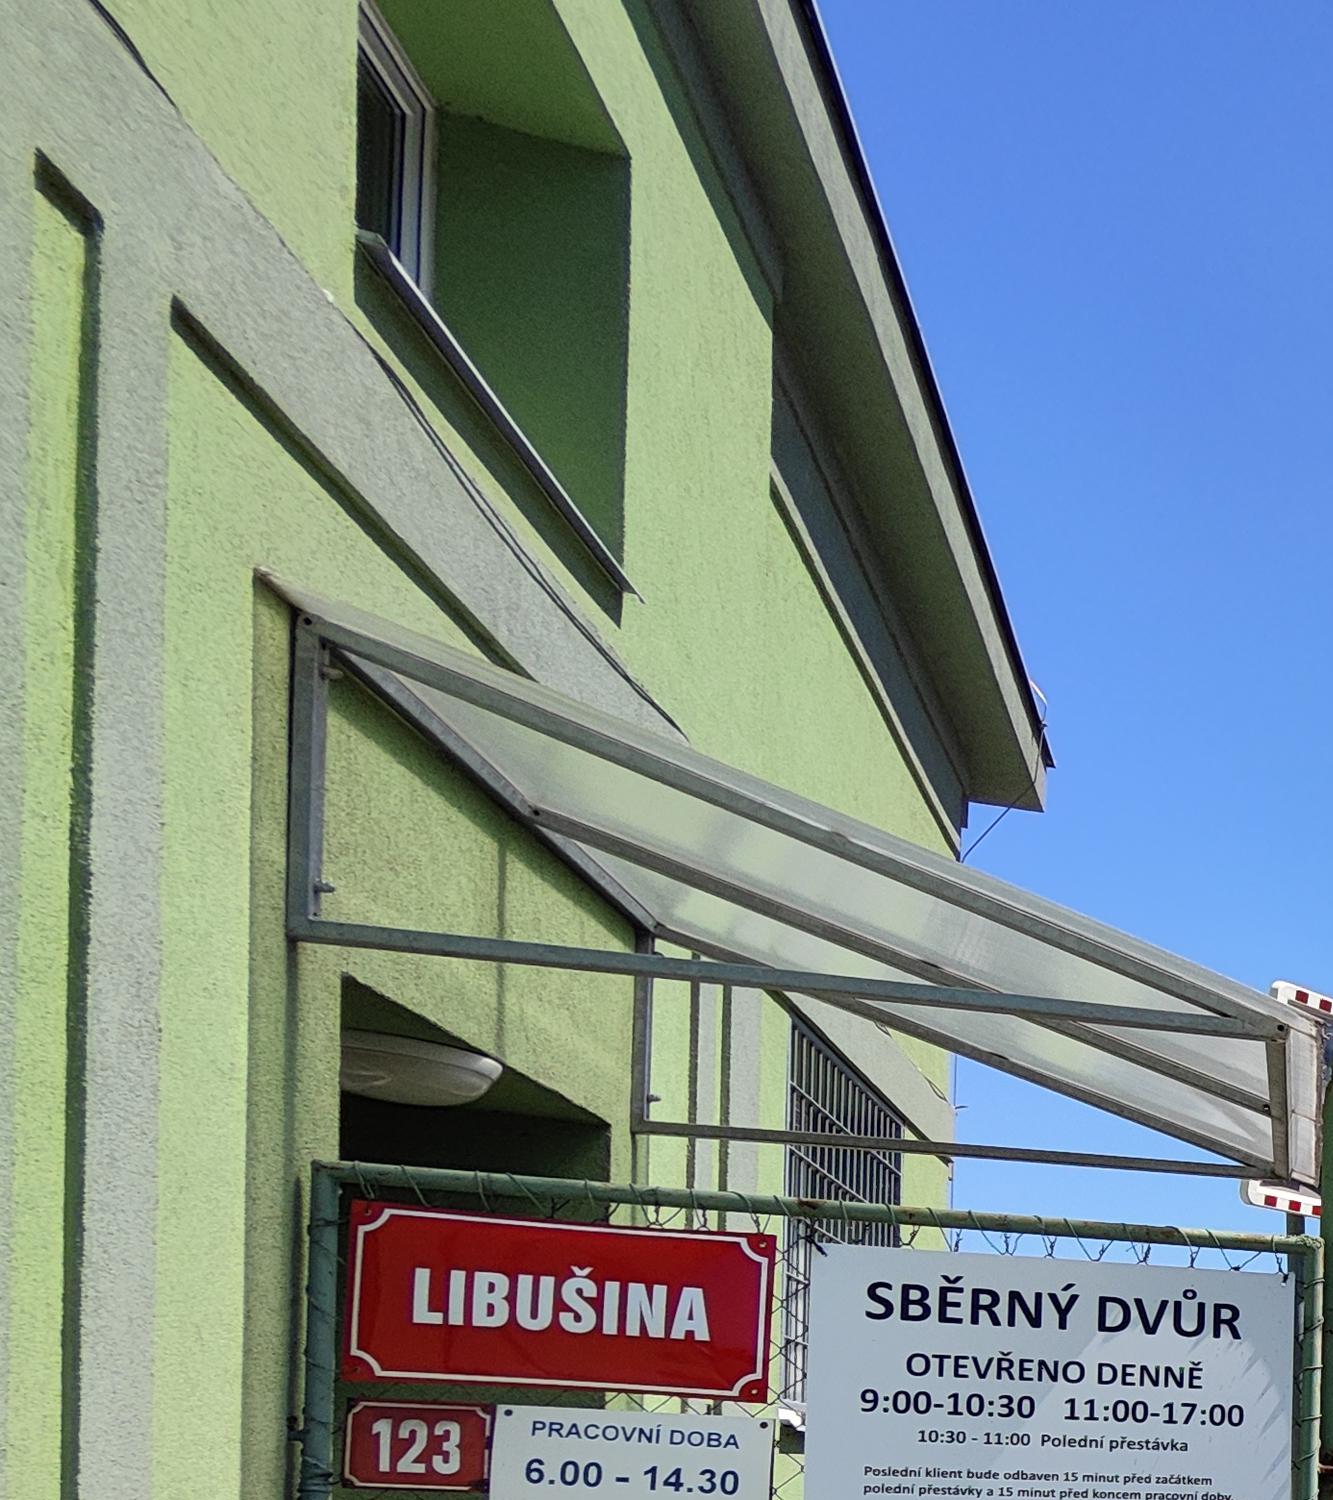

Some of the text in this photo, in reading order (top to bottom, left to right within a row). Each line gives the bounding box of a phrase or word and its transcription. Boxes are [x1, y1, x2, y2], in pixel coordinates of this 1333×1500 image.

[411, 1266, 710, 1341] LIBUŠINA
[864, 1275, 1242, 1340] SBĚRNÝ DVŮR
[905, 1351, 1203, 1390] OTEVŘENO DENNĚ
[859, 1388, 1244, 1427] 9:00-10:30 11:00-17:00
[371, 1418, 461, 1474] 123
[530, 1420, 740, 1450] PRACOVNÍ DOBA
[917, 1429, 966, 1446] 10:30
[983, 1432, 1031, 1448] 11:00
[1040, 1433, 1104, 1450] Polední
[1109, 1435, 1189, 1455] přestávka
[524, 1458, 604, 1488] 6.00
[642, 1465, 740, 1496] 14.30
[863, 1466, 1212, 1486] Poslední klient bude odbaven 15 minut před začátkem
[863, 1483, 915, 1496] polední
[918, 1484, 983, 1498] přestávky
[986, 1488, 994, 1497] a
[998, 1487, 1014, 1497] 15
[1017, 1487, 1056, 1498] minut
[1059, 1488, 1088, 1500] před
[1092, 1488, 1141, 1500] koncem
